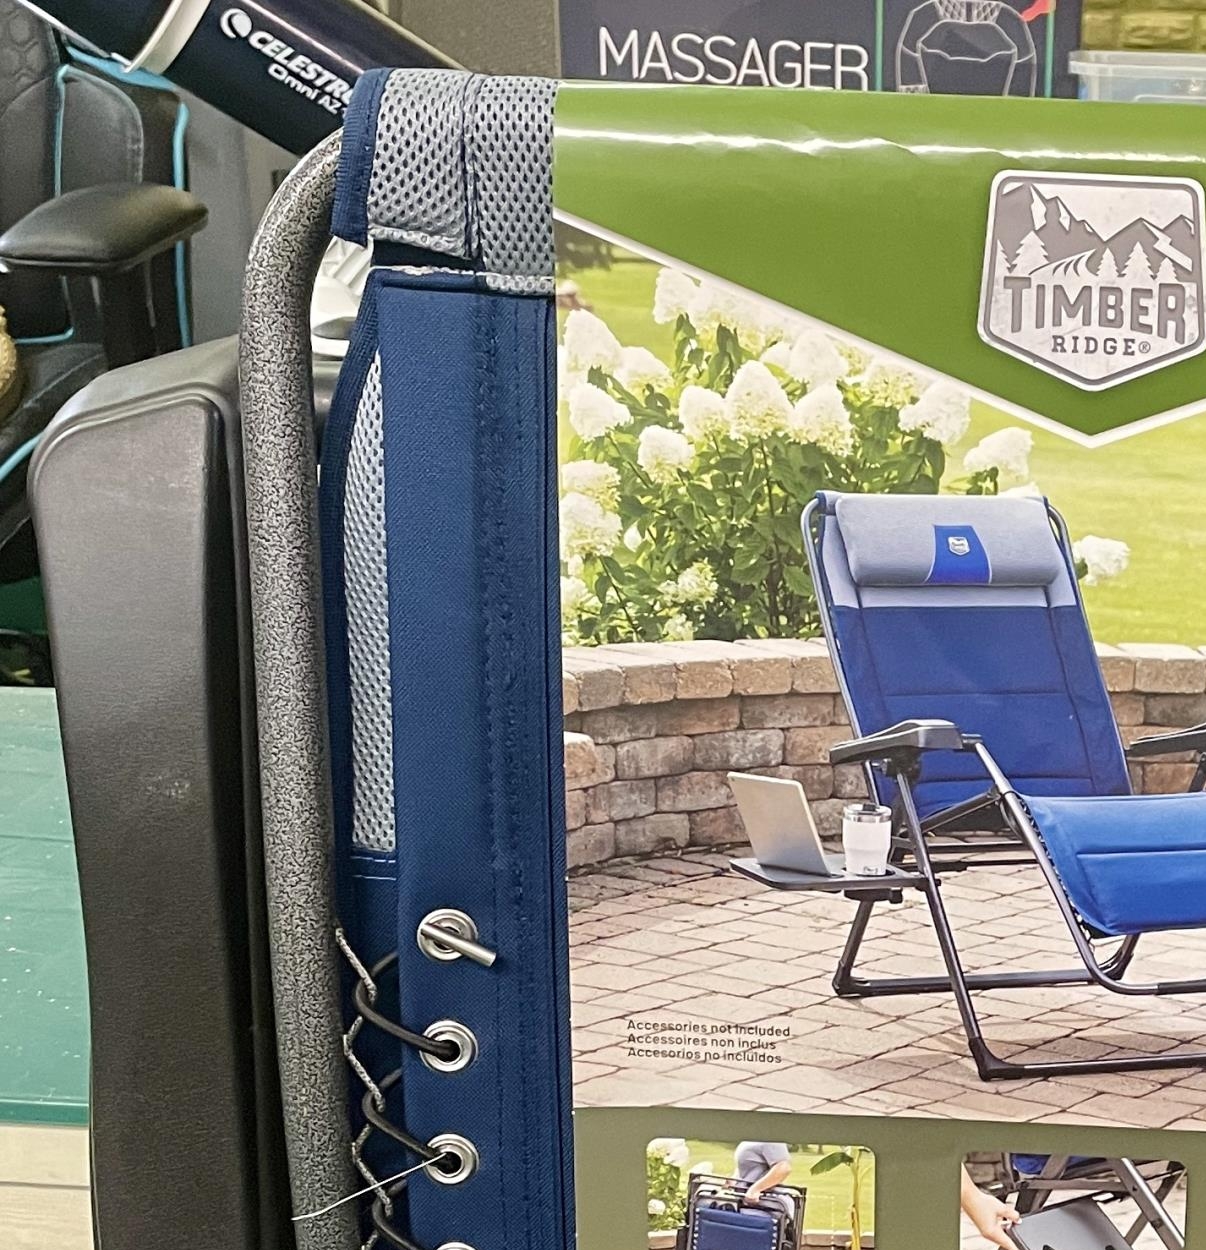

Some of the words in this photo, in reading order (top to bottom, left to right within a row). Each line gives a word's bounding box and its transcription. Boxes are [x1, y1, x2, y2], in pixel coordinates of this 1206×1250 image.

[599, 26, 869, 91] MASSAGER
[268, 63, 320, 100] Omni
[1003, 276, 1186, 345] TIMBER
[627, 1019, 708, 1034] Accessories
[711, 1025, 733, 1035] not
[735, 1024, 791, 1037] included
[627, 1033, 708, 1047] Accessoires
[710, 1038, 735, 1048] non
[738, 1037, 777, 1050] inclus
[627, 1047, 701, 1060] Accesorios
[704, 1051, 720, 1062] no
